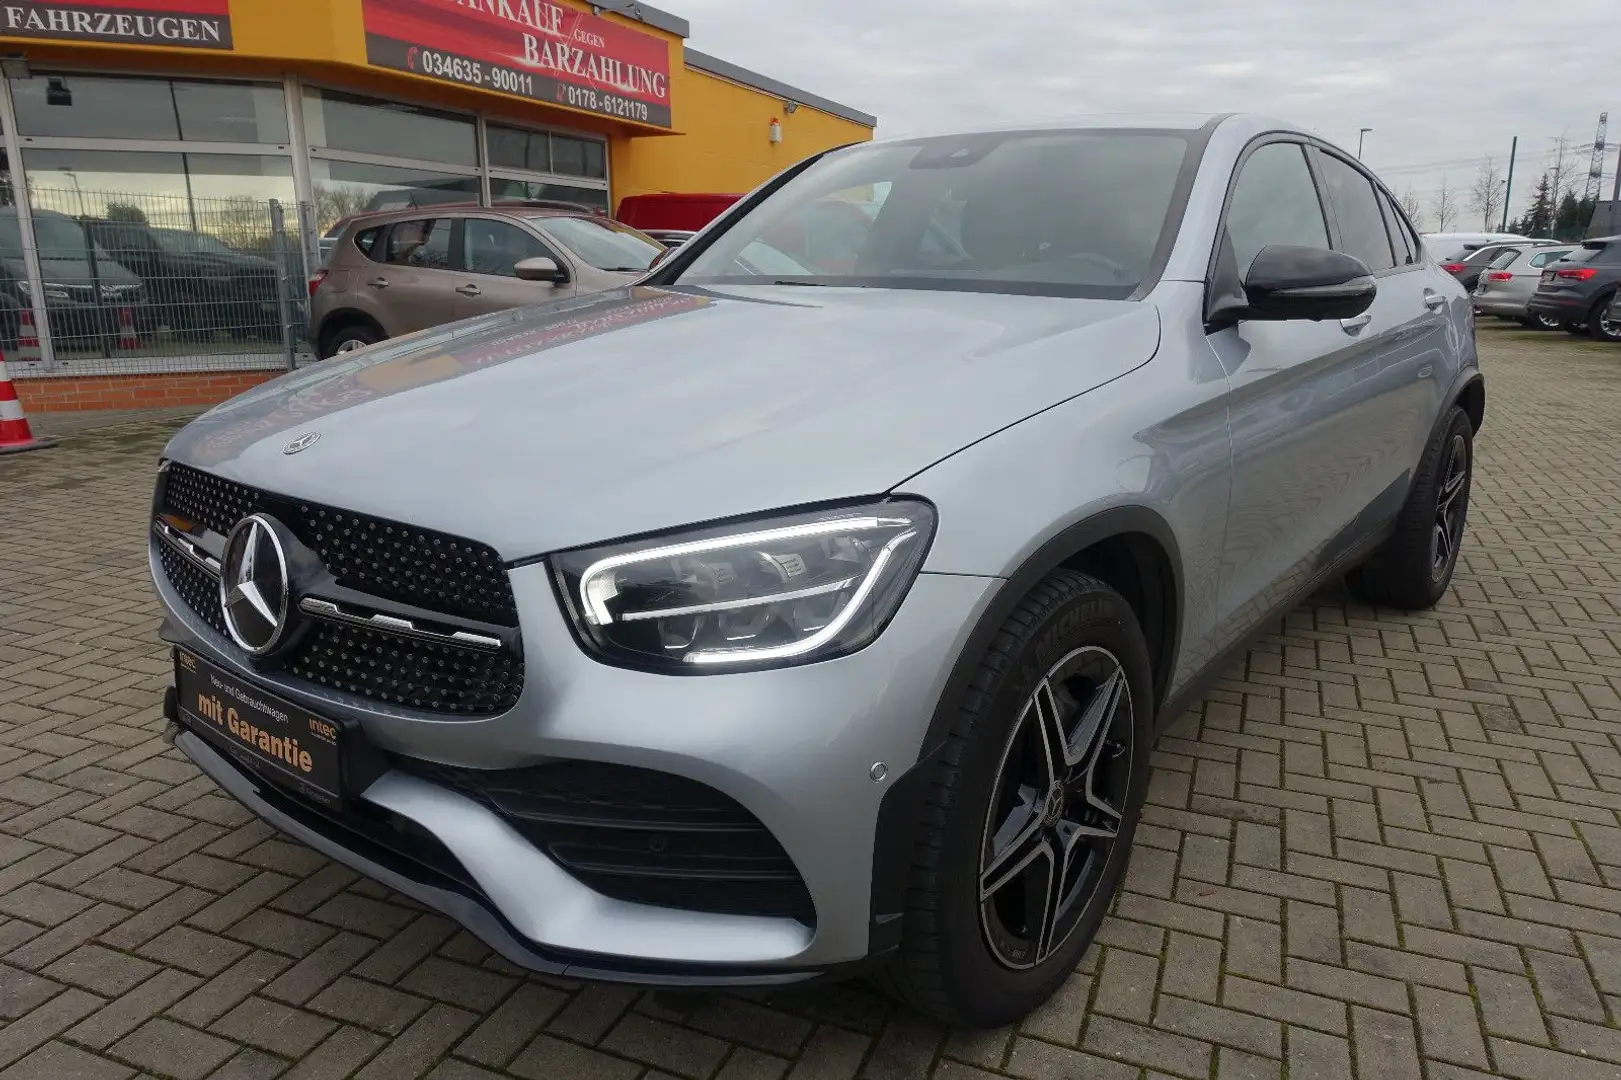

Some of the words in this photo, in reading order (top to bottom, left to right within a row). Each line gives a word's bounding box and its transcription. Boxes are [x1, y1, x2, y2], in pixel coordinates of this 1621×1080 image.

[4, 6, 220, 42] FAHRZEUGEN
[573, 28, 605, 49] GEGEN
[522, 33, 667, 98] BARZAHLUNG
[235, 688, 289, 723] Gebrauchtwagen
[198, 692, 223, 726] mit
[227, 707, 313, 773] Garantie
